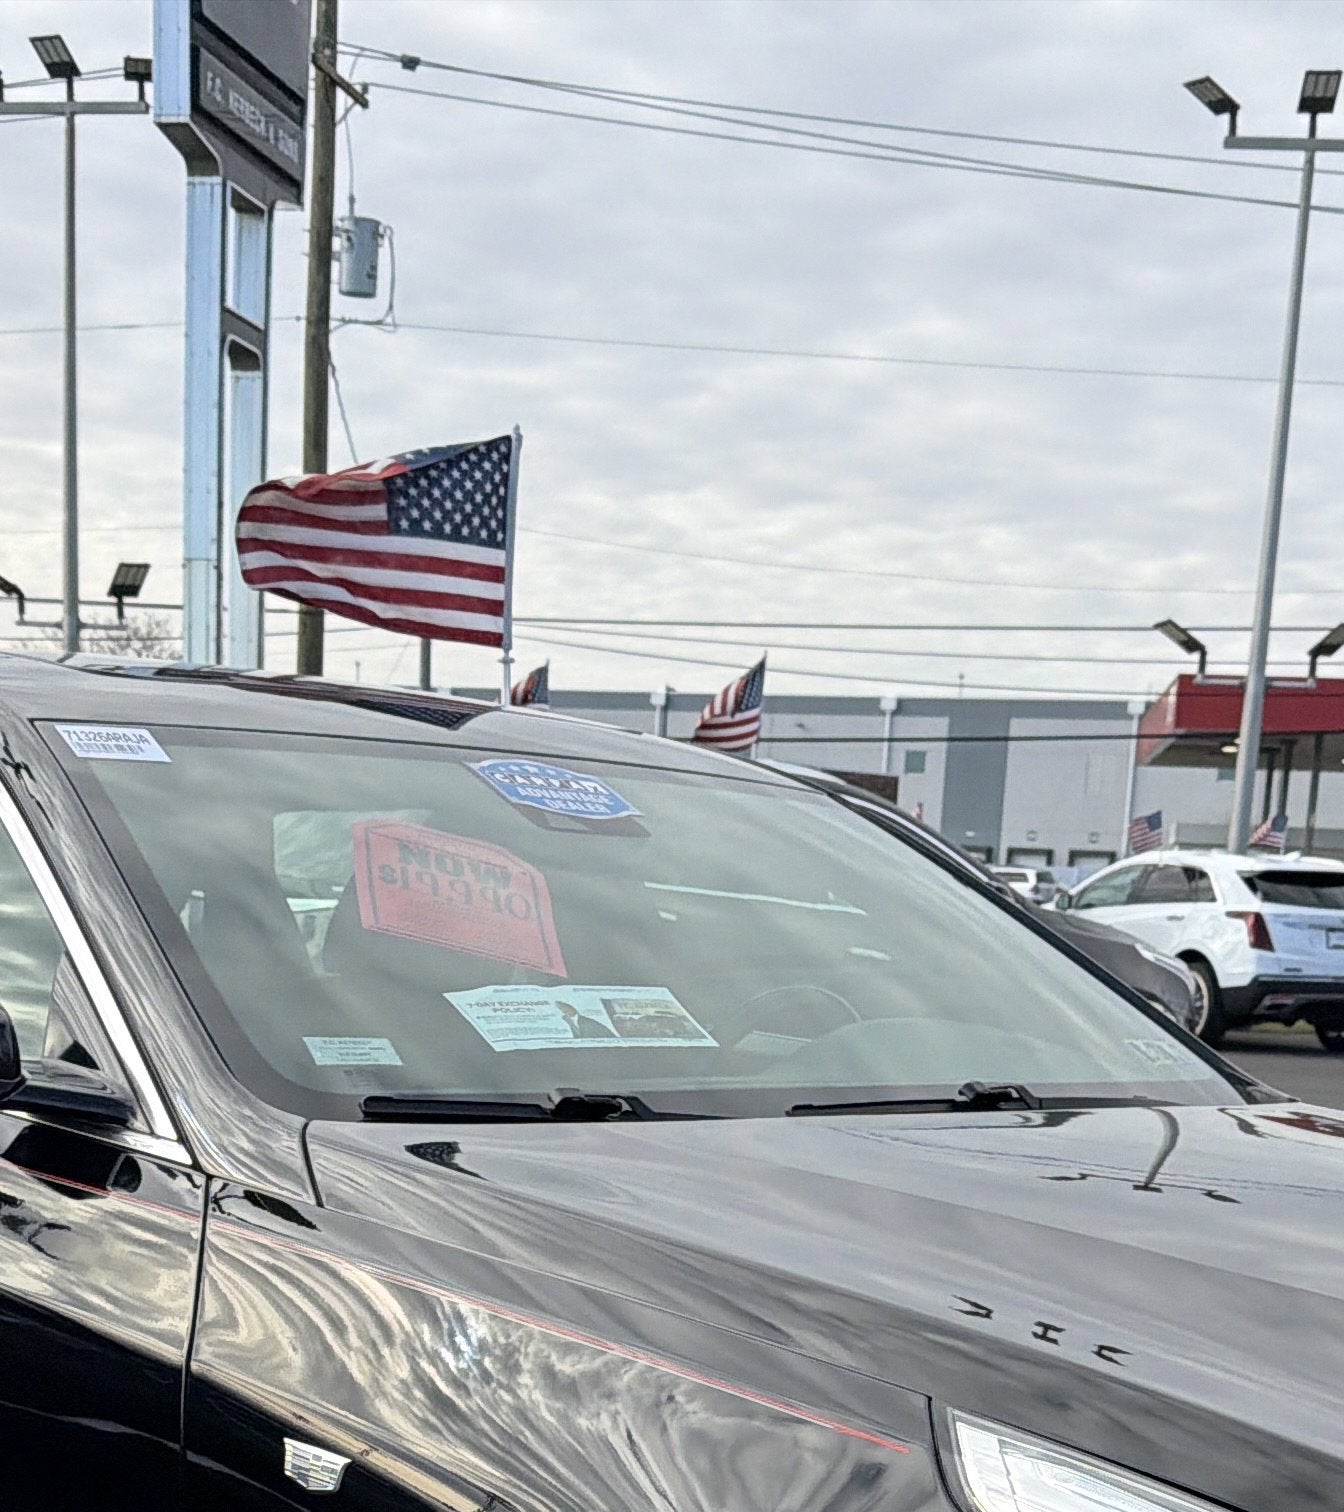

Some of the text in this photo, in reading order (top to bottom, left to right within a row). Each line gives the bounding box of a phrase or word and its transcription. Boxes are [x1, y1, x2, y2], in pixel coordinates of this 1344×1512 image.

[491, 771, 609, 796] CARFAX
[516, 786, 615, 806] ADVANTAGE
[544, 798, 611, 814] DEALER
